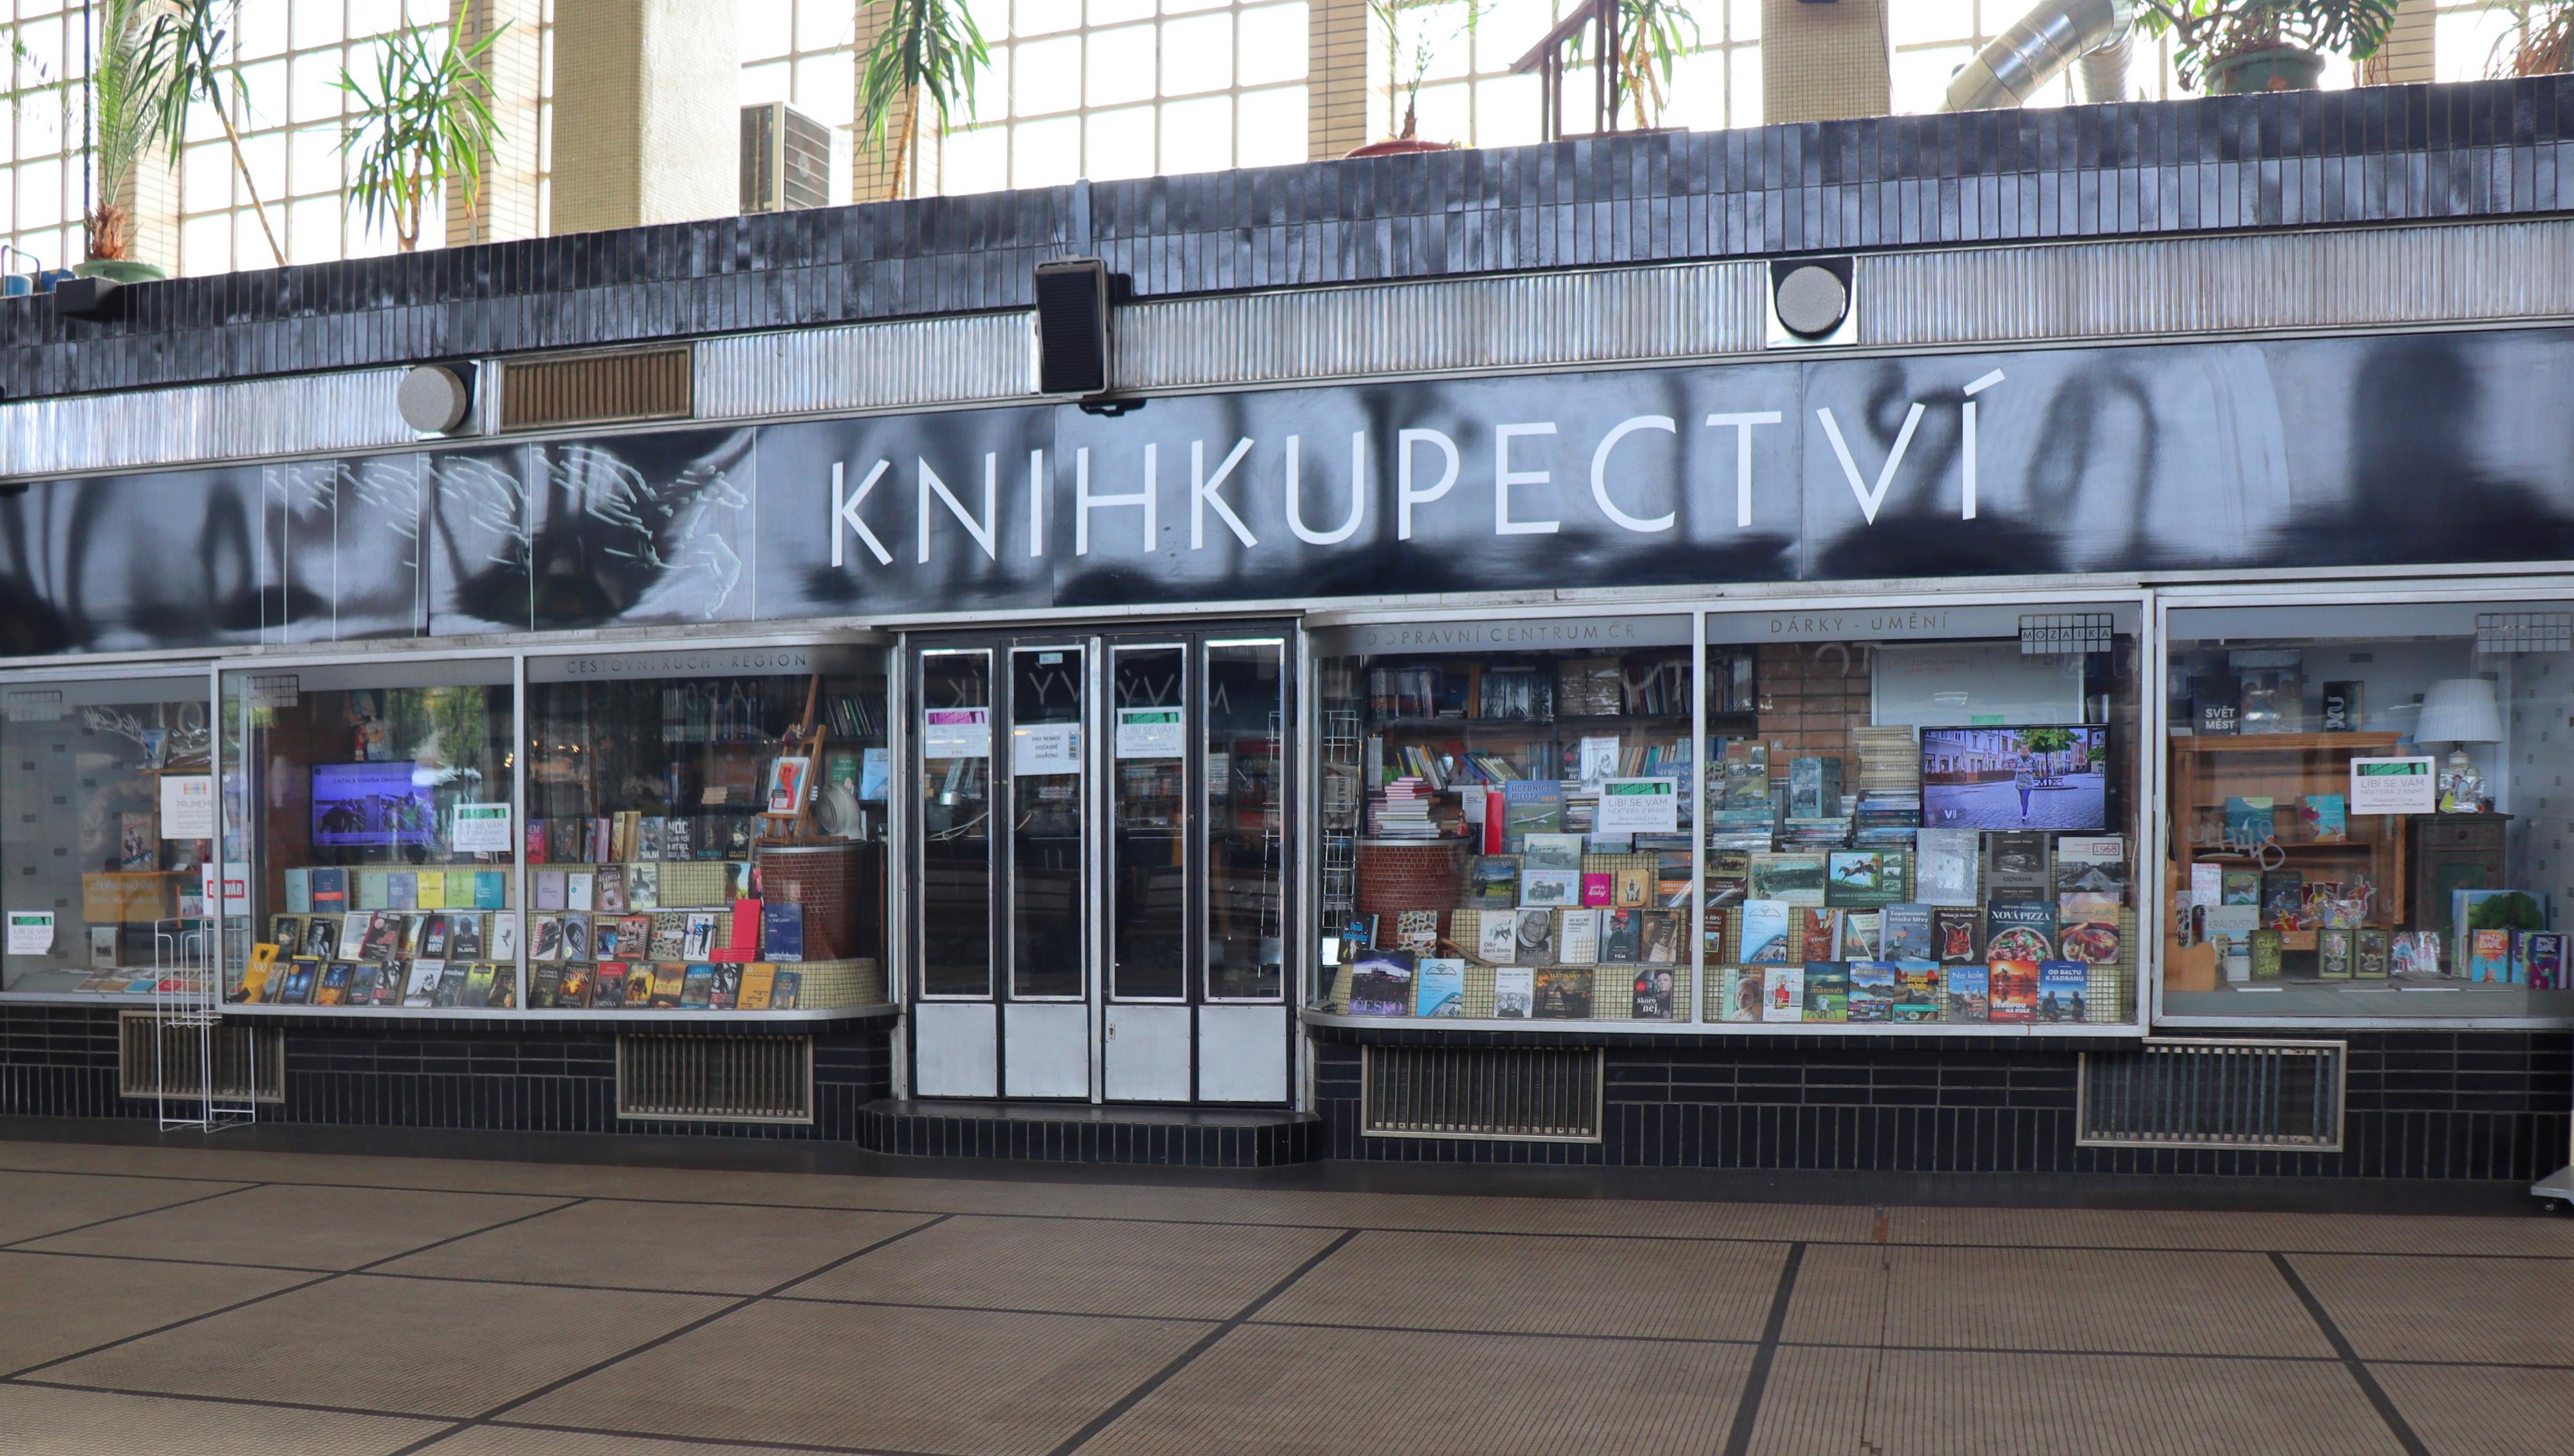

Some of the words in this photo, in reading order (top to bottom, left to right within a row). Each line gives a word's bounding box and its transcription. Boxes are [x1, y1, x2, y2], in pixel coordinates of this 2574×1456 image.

[830, 369, 2004, 567] KNIHKUPECTVÍ
[1771, 615, 1842, 634] DÁRKY
[1871, 611, 1947, 631] UMĚNÍ
[1367, 624, 1481, 647] DOPRAVNÍ
[1490, 625, 1598, 643] CENTRUM
[1609, 620, 1636, 639] ČR
[2022, 628, 2111, 641] MOZAIKA
[566, 652, 655, 674] CESTOVNÍ
[663, 654, 711, 670] RUCH
[731, 653, 808, 669] REGION
[2205, 705, 2234, 718] SVĚT
[1124, 725, 1140, 735] LÍBÍ
[1143, 726, 1154, 734] SE
[1156, 724, 1176, 733] VÁM
[2205, 719, 2234, 730] MĚST
[1512, 784, 1551, 793] UČEBNICE
[2360, 777, 2381, 788] LÍBÍ
[2384, 779, 2397, 788] SE
[2400, 777, 2425, 787] VÁM
[1512, 793, 1539, 801] PILOTA
[1609, 797, 1627, 807] LÍBÍ
[1630, 798, 1642, 807] SE
[1643, 797, 1668, 806] VÁM
[486, 820, 505, 829] VÁM
[667, 822, 689, 834] NOC
[2095, 845, 2117, 854] 1968
[207, 882, 243, 895] BVÁR
[1992, 909, 2019, 921] NOVÁ
[2020, 910, 2051, 921] PIZZA
[2208, 917, 2259, 930] KRÁLOVSTVÍ
[2479, 941, 2503, 950] DAHL
[1952, 971, 1965, 979] Na
[1968, 970, 1984, 979] kole
[1353, 996, 1403, 1013] ČESKO
[1642, 1002, 1658, 1015] nej
